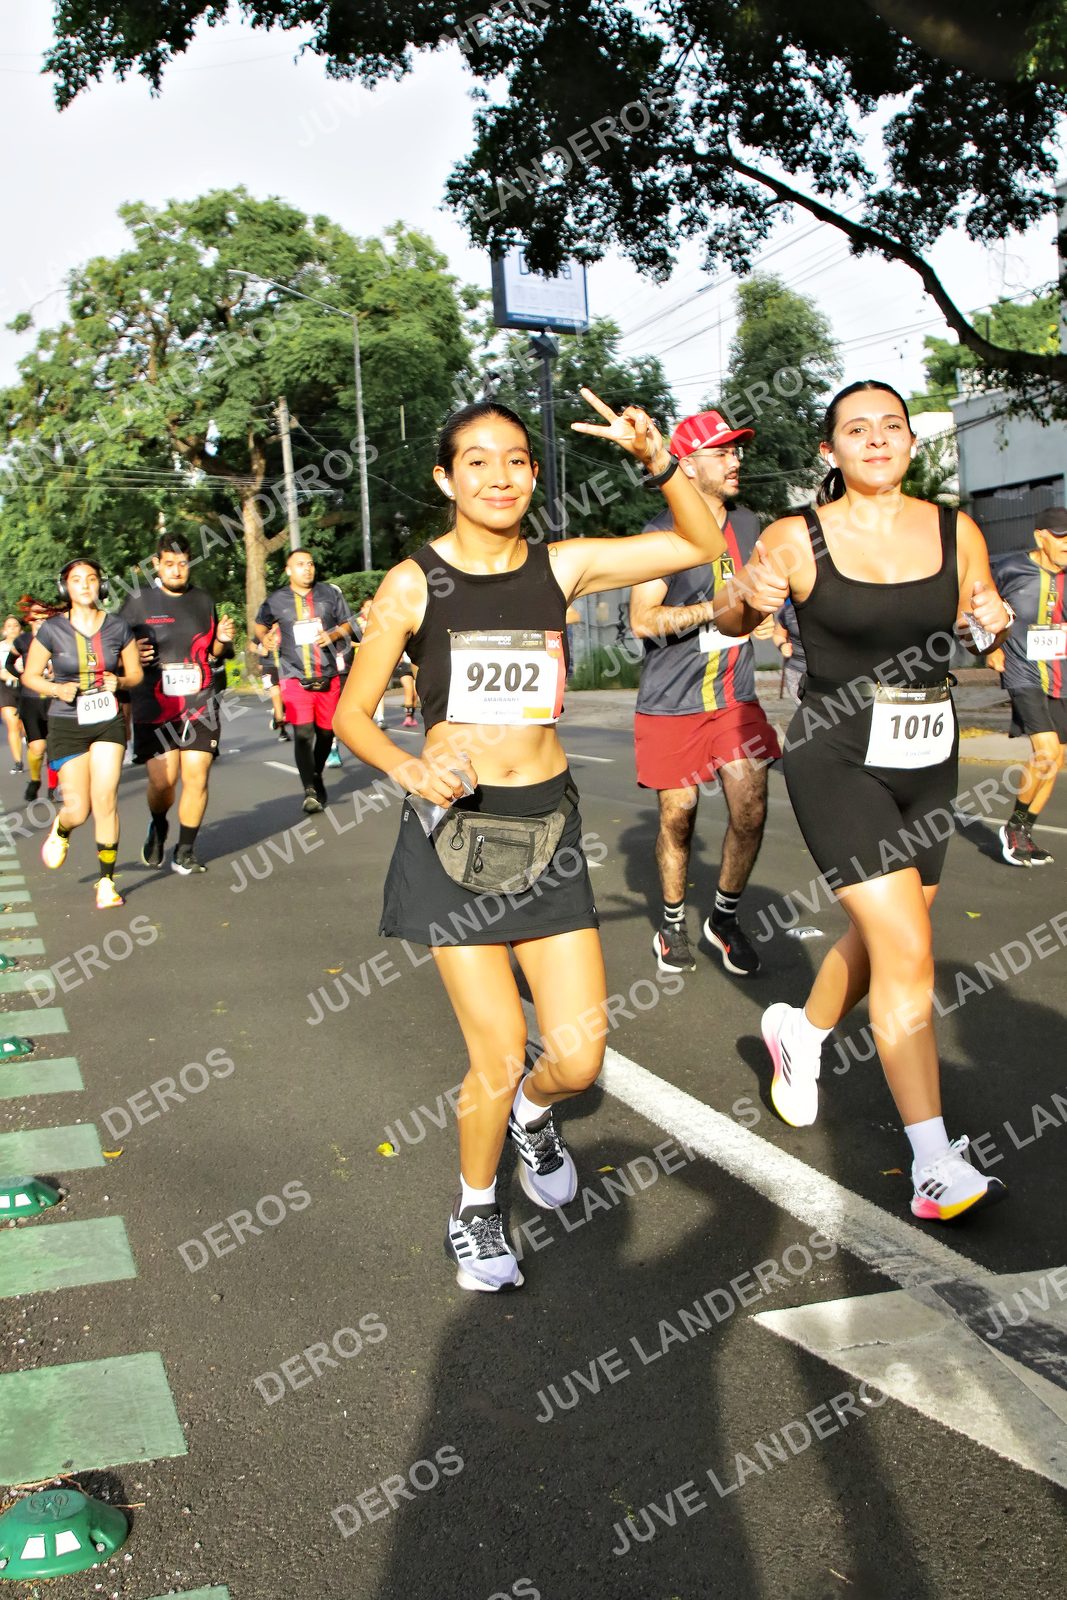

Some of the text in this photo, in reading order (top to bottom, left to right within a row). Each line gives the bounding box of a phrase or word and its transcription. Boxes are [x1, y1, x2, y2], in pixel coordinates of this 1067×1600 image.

[466, 662, 540, 692] 9202
[84, 696, 110, 712] 8100
[890, 712, 944, 740] 1016
